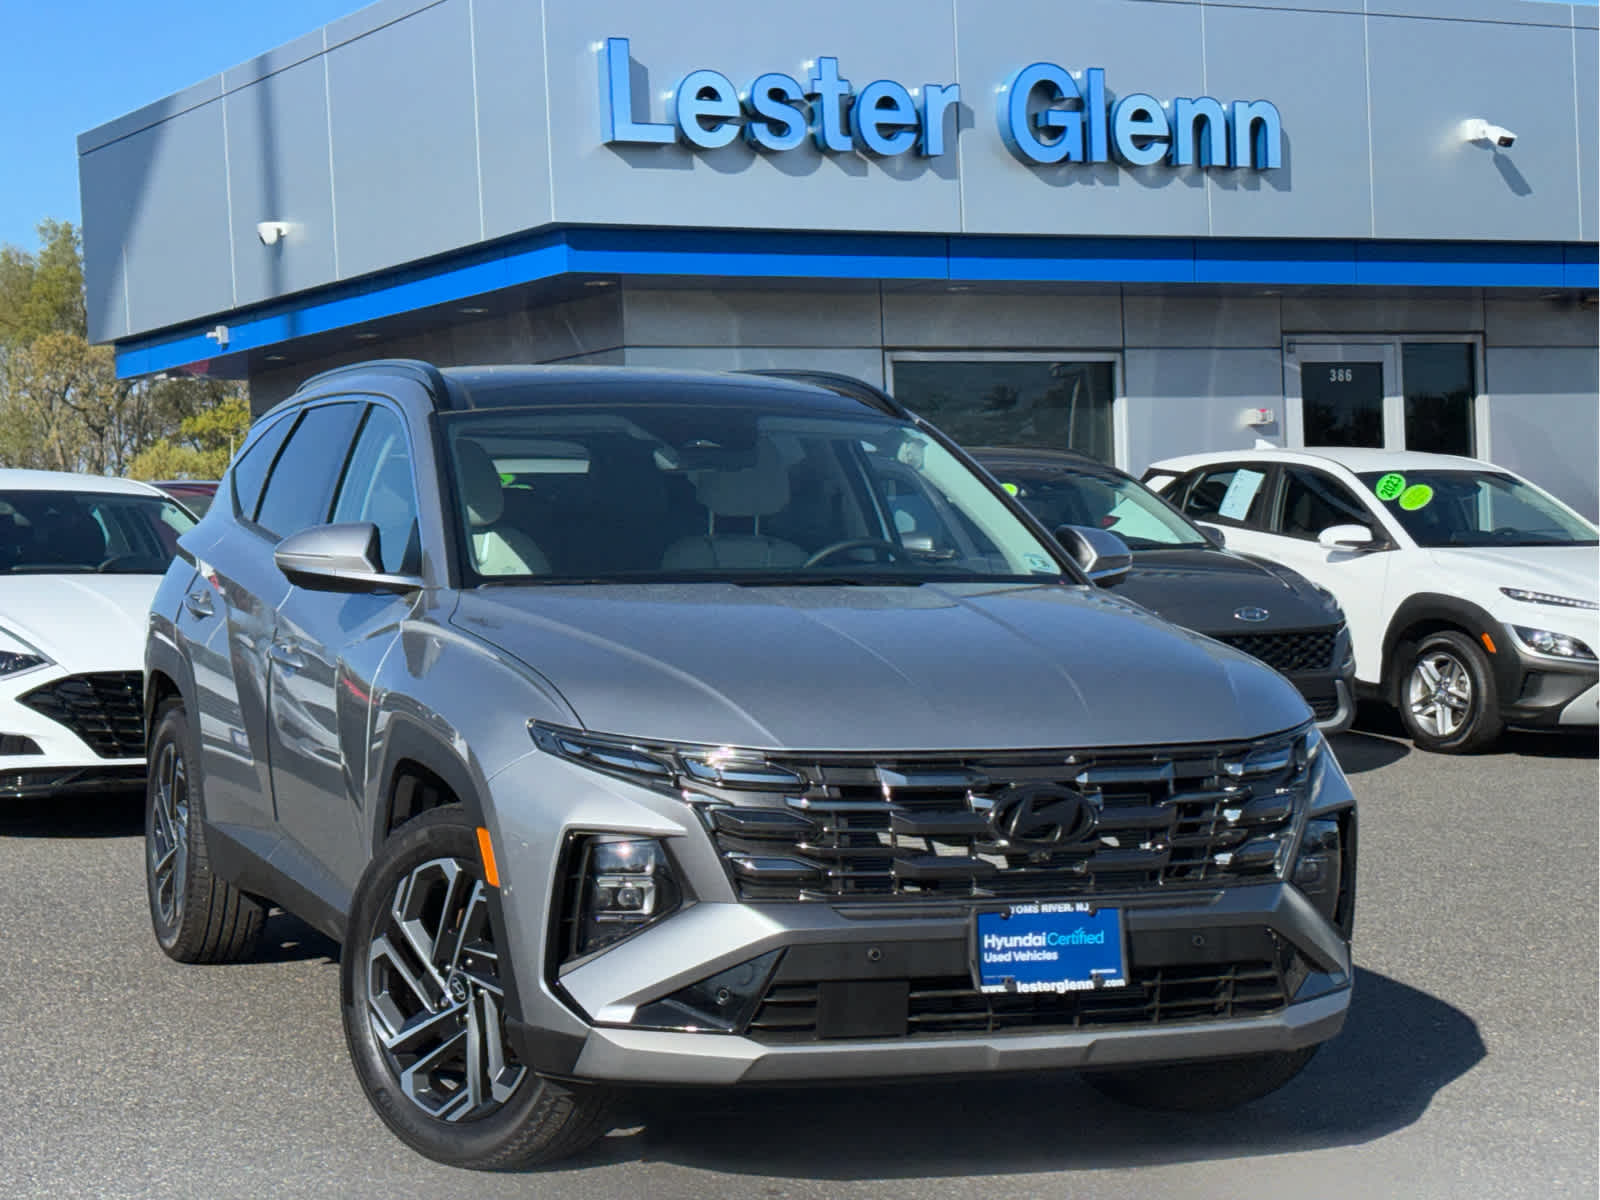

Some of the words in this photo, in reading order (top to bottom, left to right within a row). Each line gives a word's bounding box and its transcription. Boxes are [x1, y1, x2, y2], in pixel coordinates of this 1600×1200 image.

[600, 37, 960, 157] Lester
[997, 62, 1281, 169] Glenn
[1329, 368, 1352, 382] 386
[1380, 475, 1402, 498] 2023
[1009, 903, 1040, 914] TOMS
[1075, 902, 1090, 912] NJ
[983, 932, 1047, 951] Hyundai
[1047, 927, 1105, 946] Certified
[983, 952, 1012, 963] Used
[1013, 950, 1059, 962] Vehicles
[1015, 979, 1095, 994] lesterglenn
